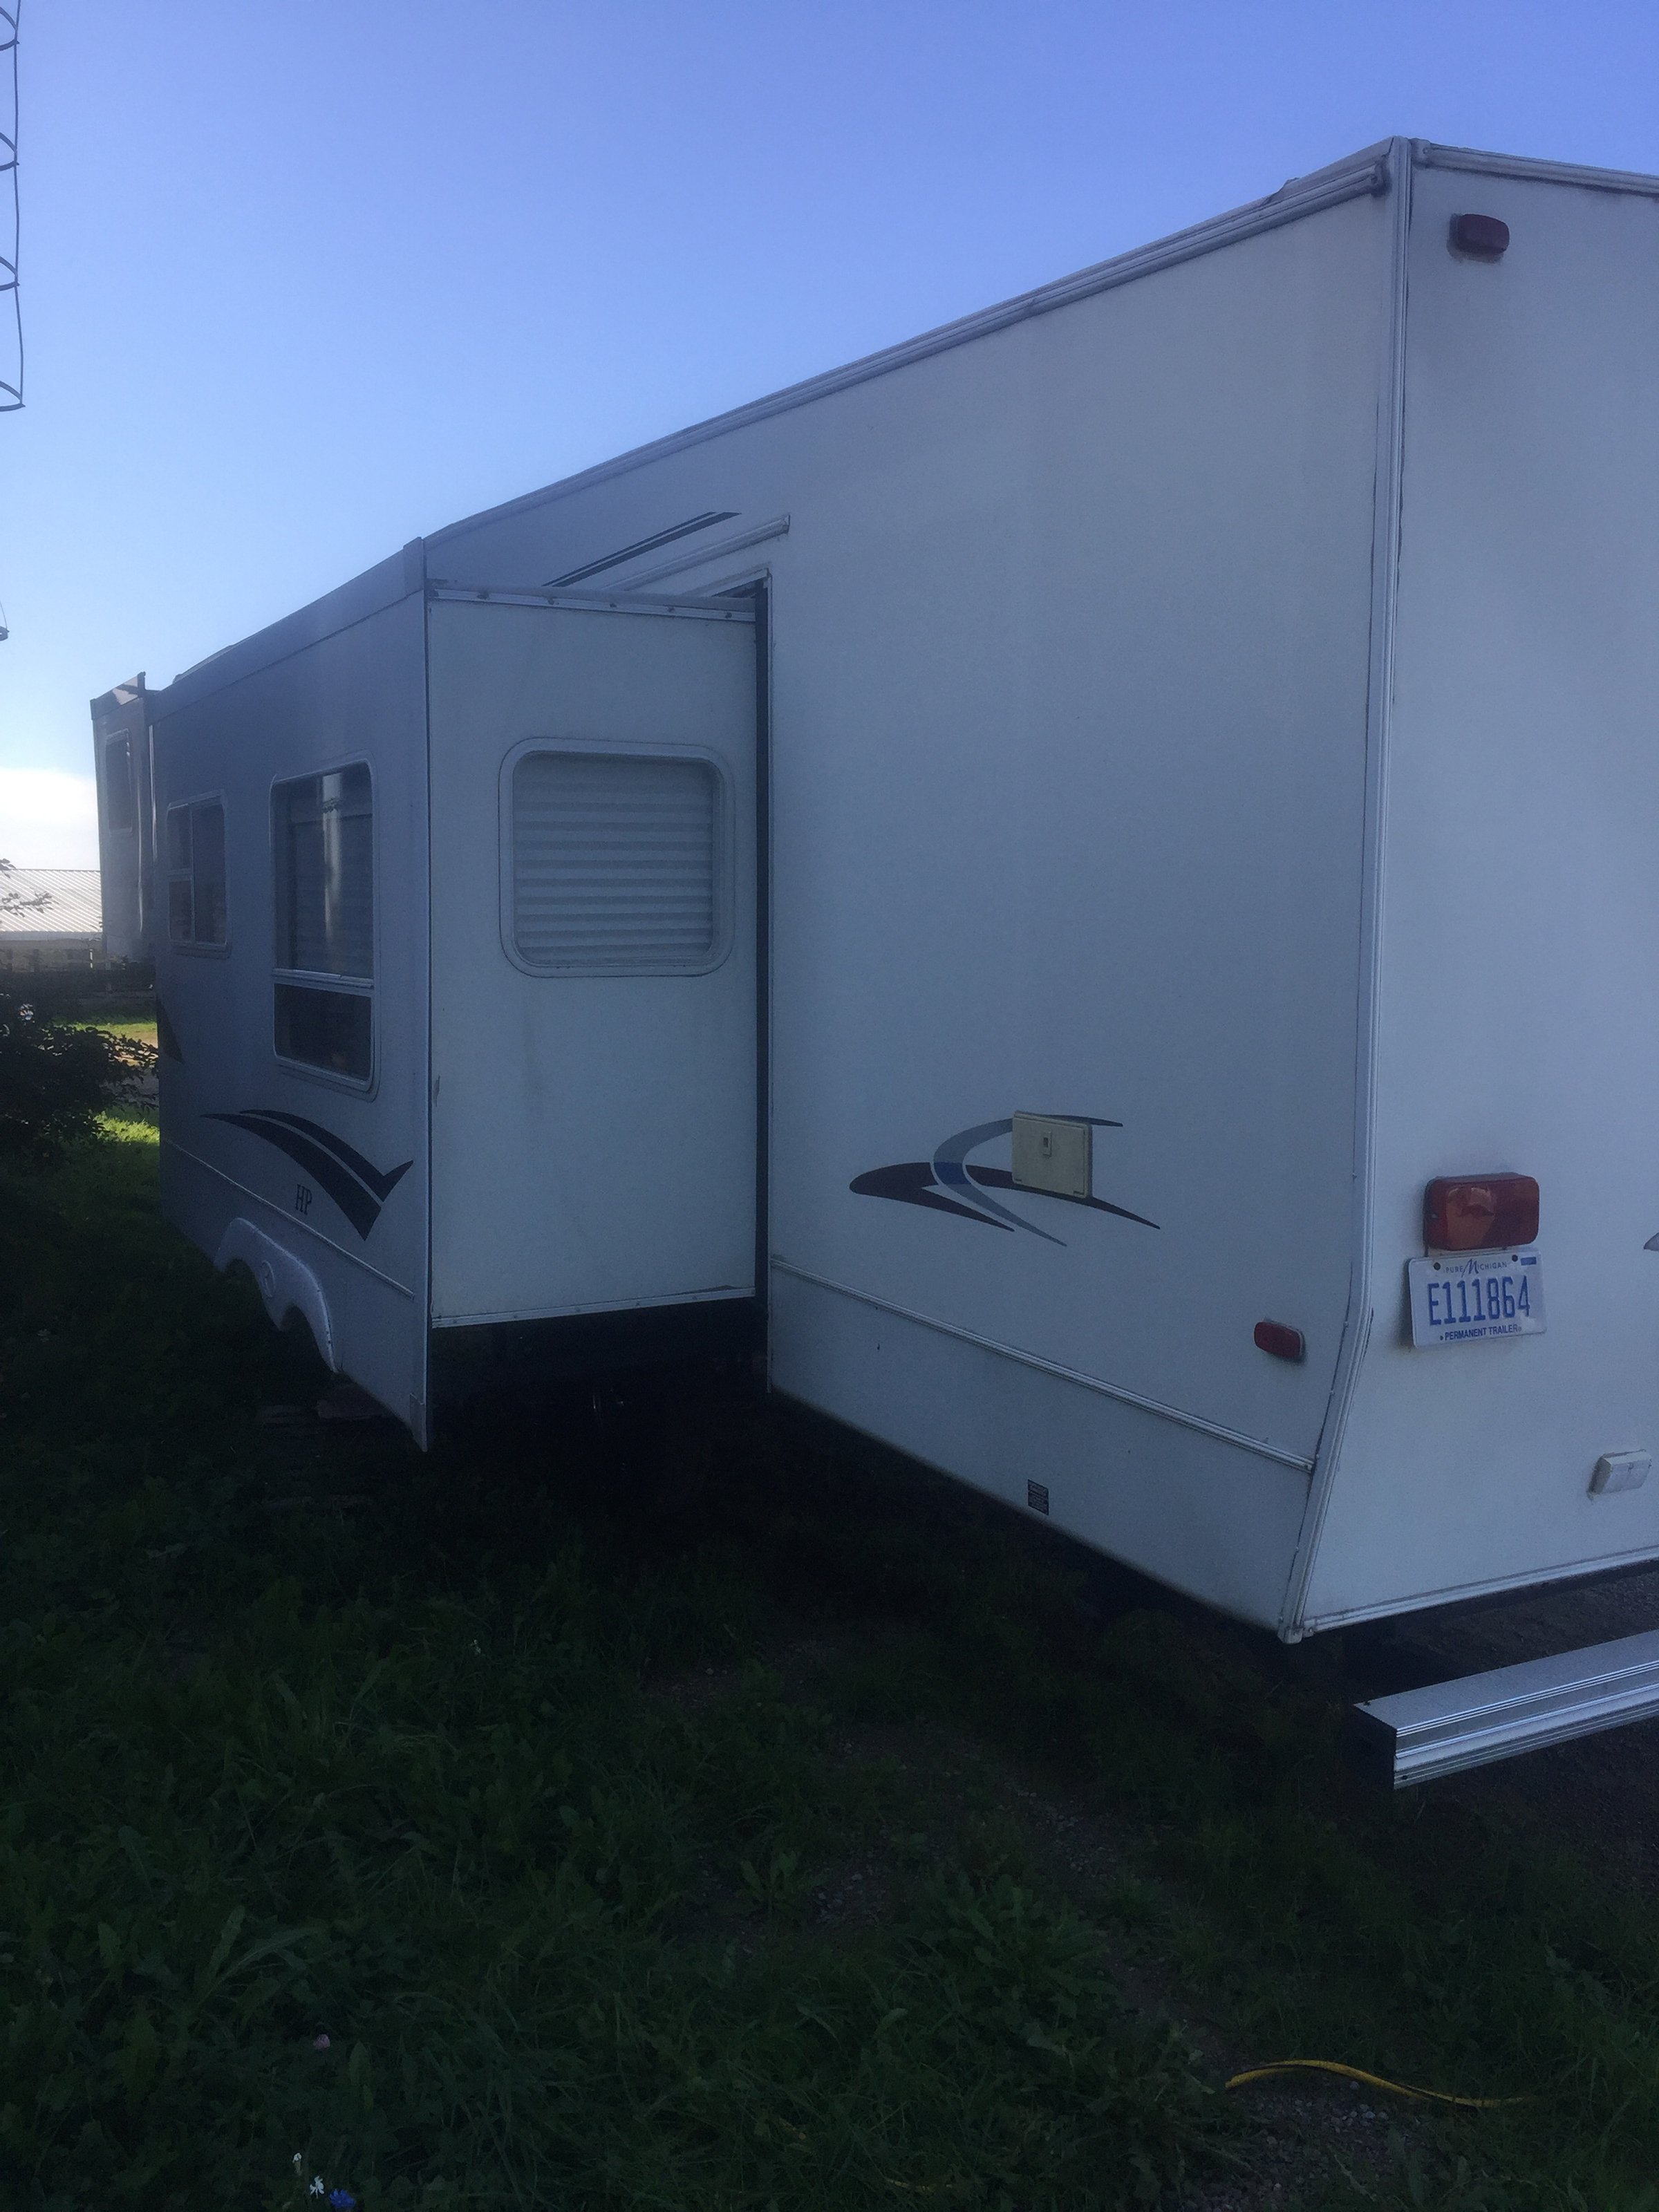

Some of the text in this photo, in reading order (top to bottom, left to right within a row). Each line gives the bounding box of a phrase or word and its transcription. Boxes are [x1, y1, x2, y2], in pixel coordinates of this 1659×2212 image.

[295, 1183, 312, 1215] HP
[1461, 1259, 1507, 1277] MICHIGAN
[1427, 1275, 1530, 1325] E111864
[1445, 1324, 1518, 1341] PERMANENT TRAILER
